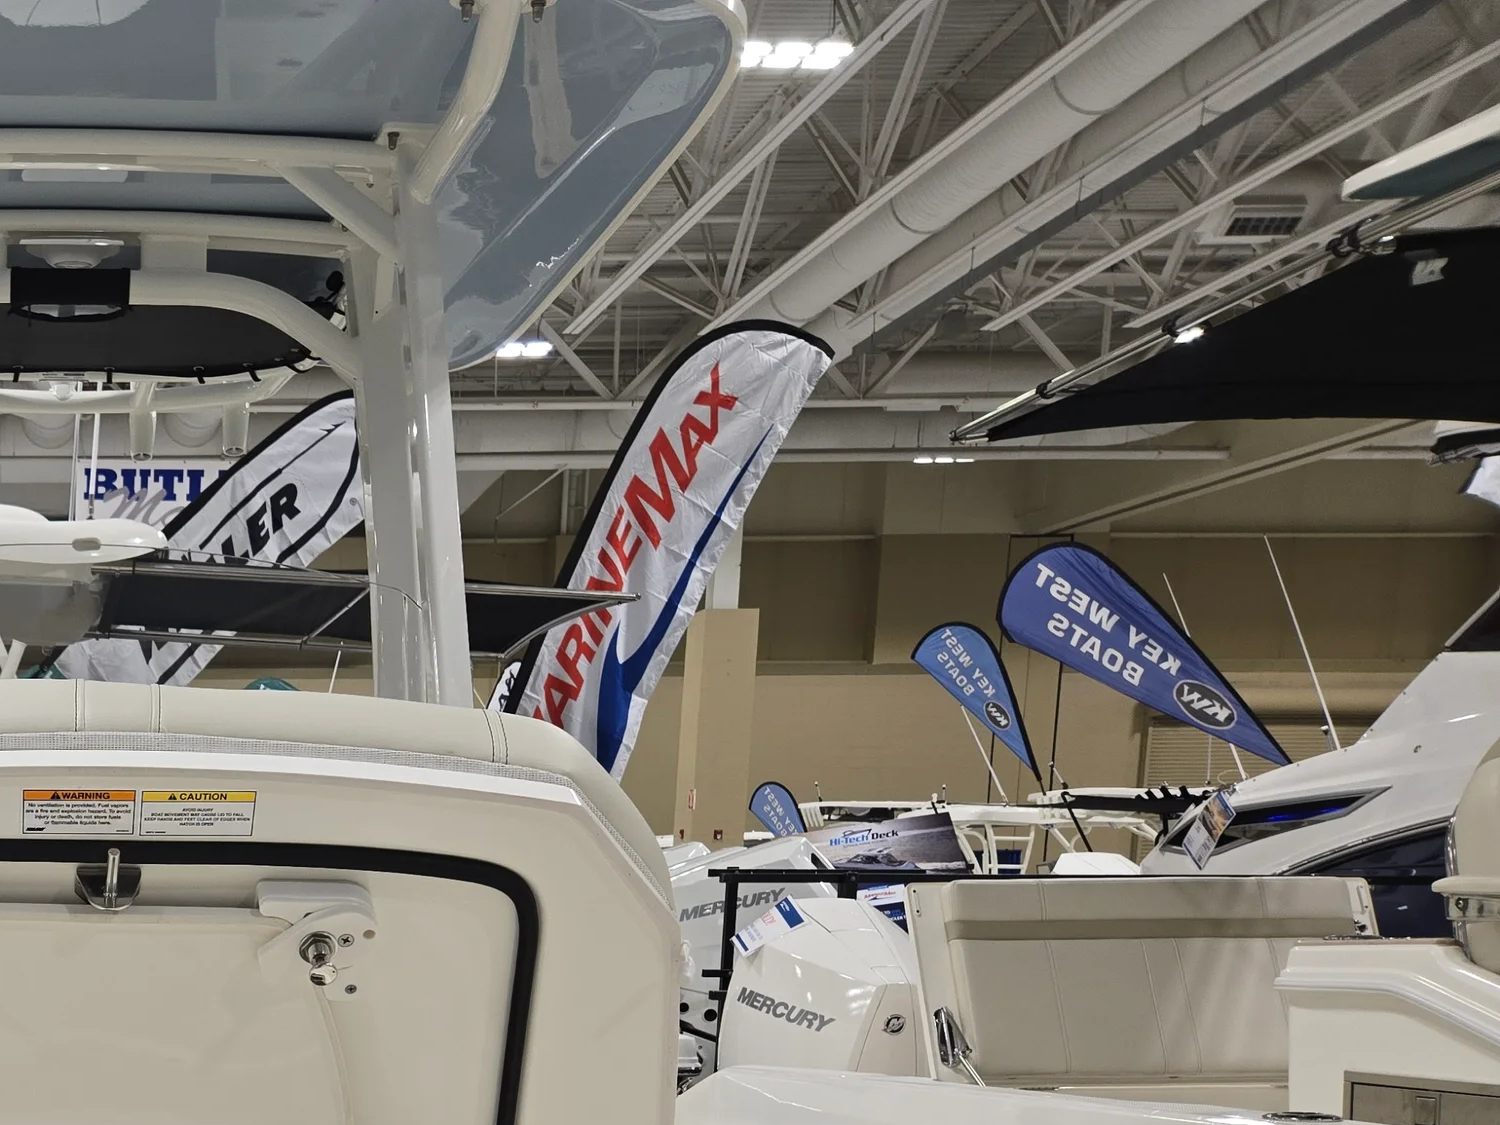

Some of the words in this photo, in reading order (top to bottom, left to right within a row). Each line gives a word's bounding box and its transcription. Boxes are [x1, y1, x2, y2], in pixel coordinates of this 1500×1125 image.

[83, 468, 206, 502] BUTL
[532, 361, 738, 729] ARINEMAX
[61, 792, 111, 800] WARNING
[179, 793, 228, 801] CAUTION
[871, 829, 899, 840] Deck
[737, 986, 837, 1033] MERCURY
